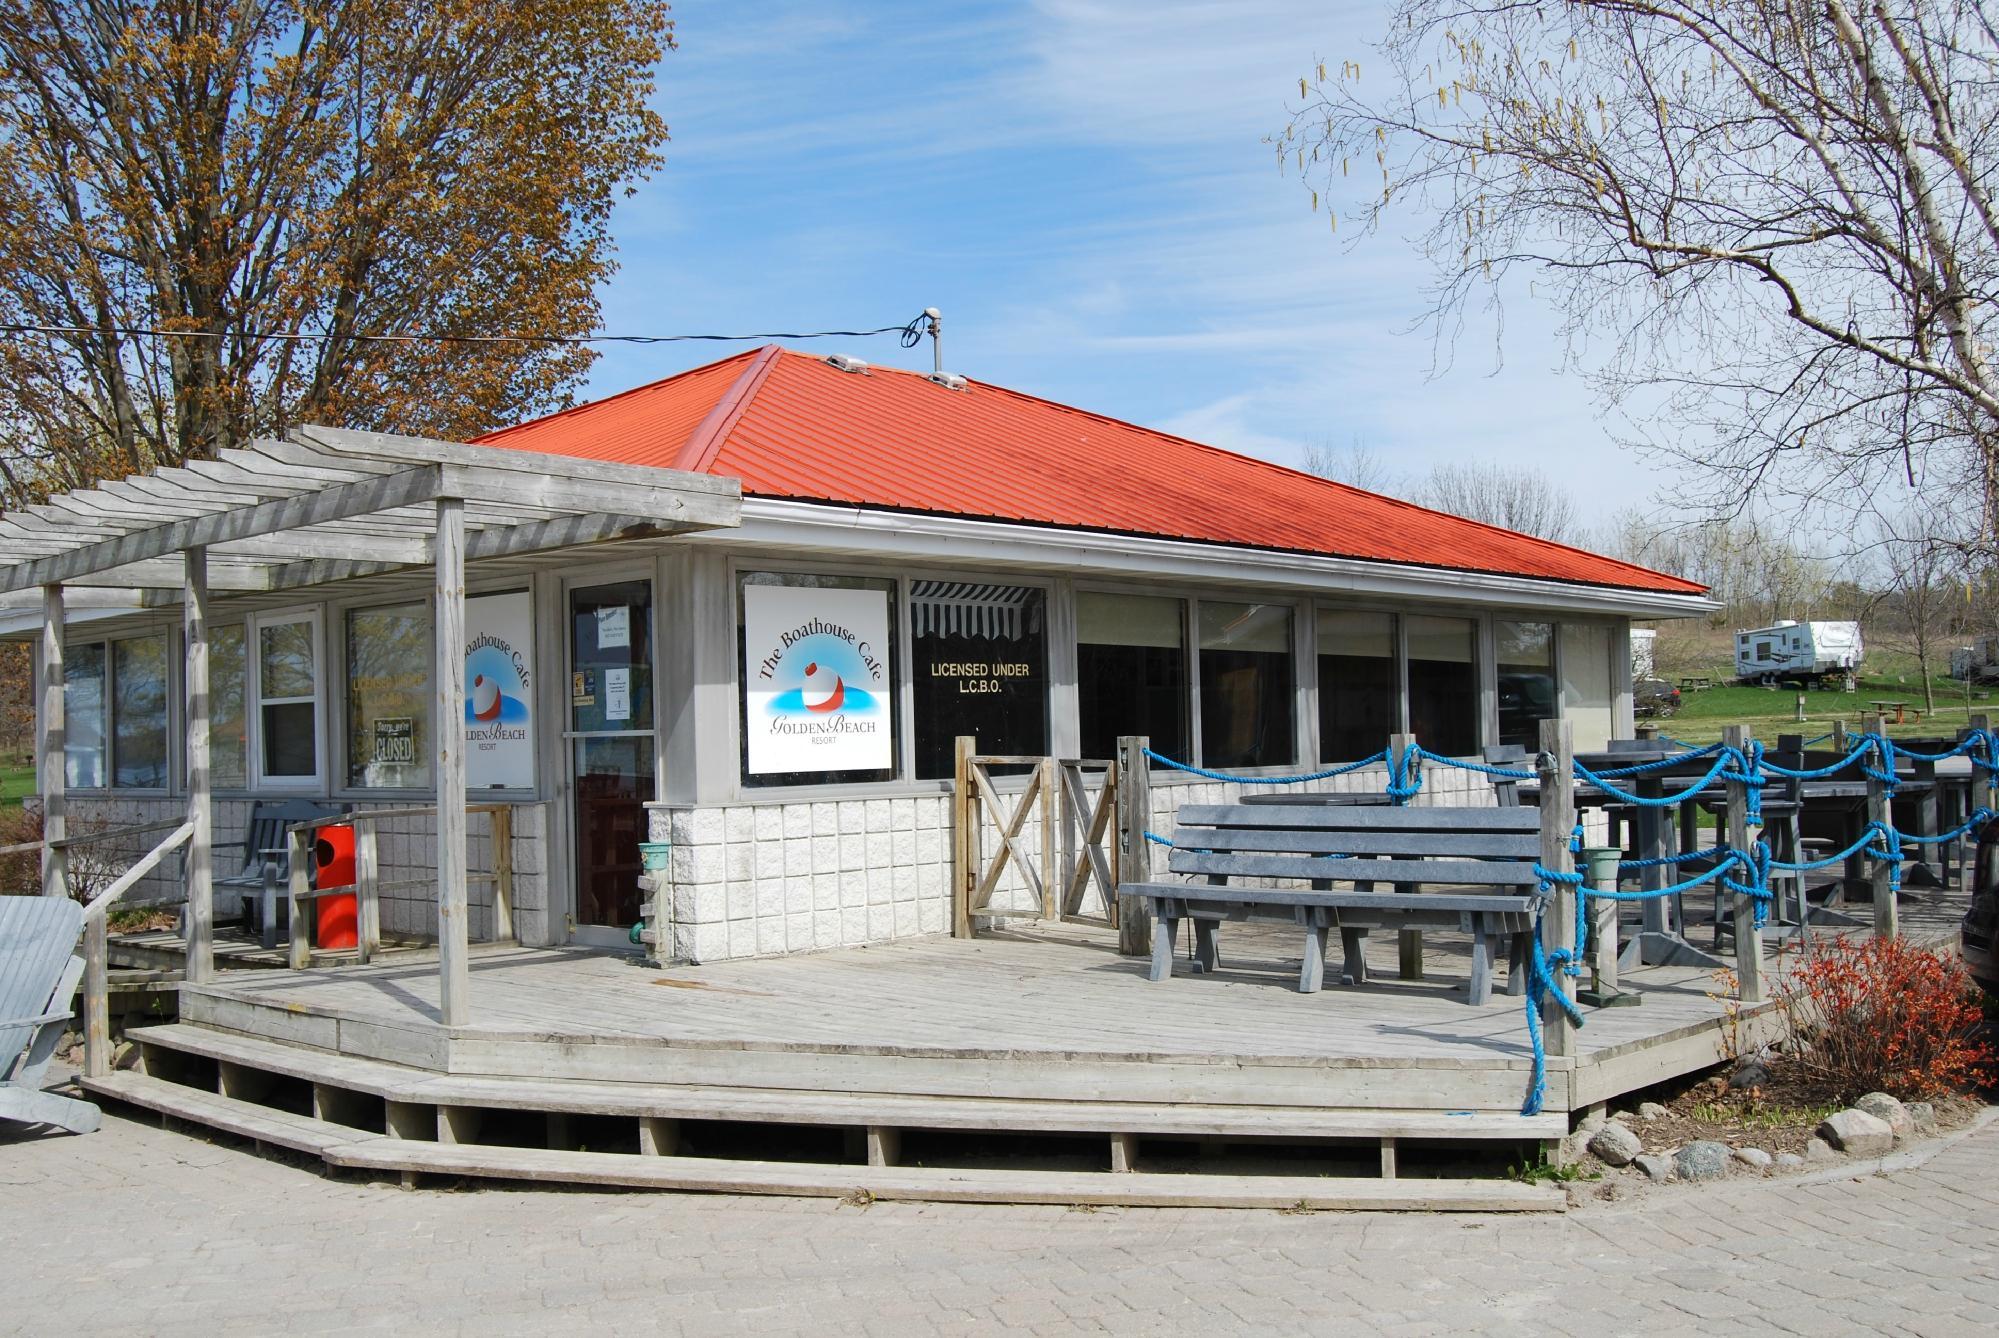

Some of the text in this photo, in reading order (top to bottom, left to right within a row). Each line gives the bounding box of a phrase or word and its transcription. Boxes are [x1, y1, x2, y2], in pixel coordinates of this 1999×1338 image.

[759, 617, 882, 682] The Boathouse Cafe
[465, 631, 531, 691] oathouse Cafe
[931, 663, 1030, 676] LICENSED UNDER
[959, 680, 1002, 693] L.C.B.O.
[465, 722, 526, 741] LDEN BEACH
[770, 714, 876, 735] GOLDEN BEACH
[376, 736, 412, 761] CLOSED
[811, 736, 837, 745] RESORT
